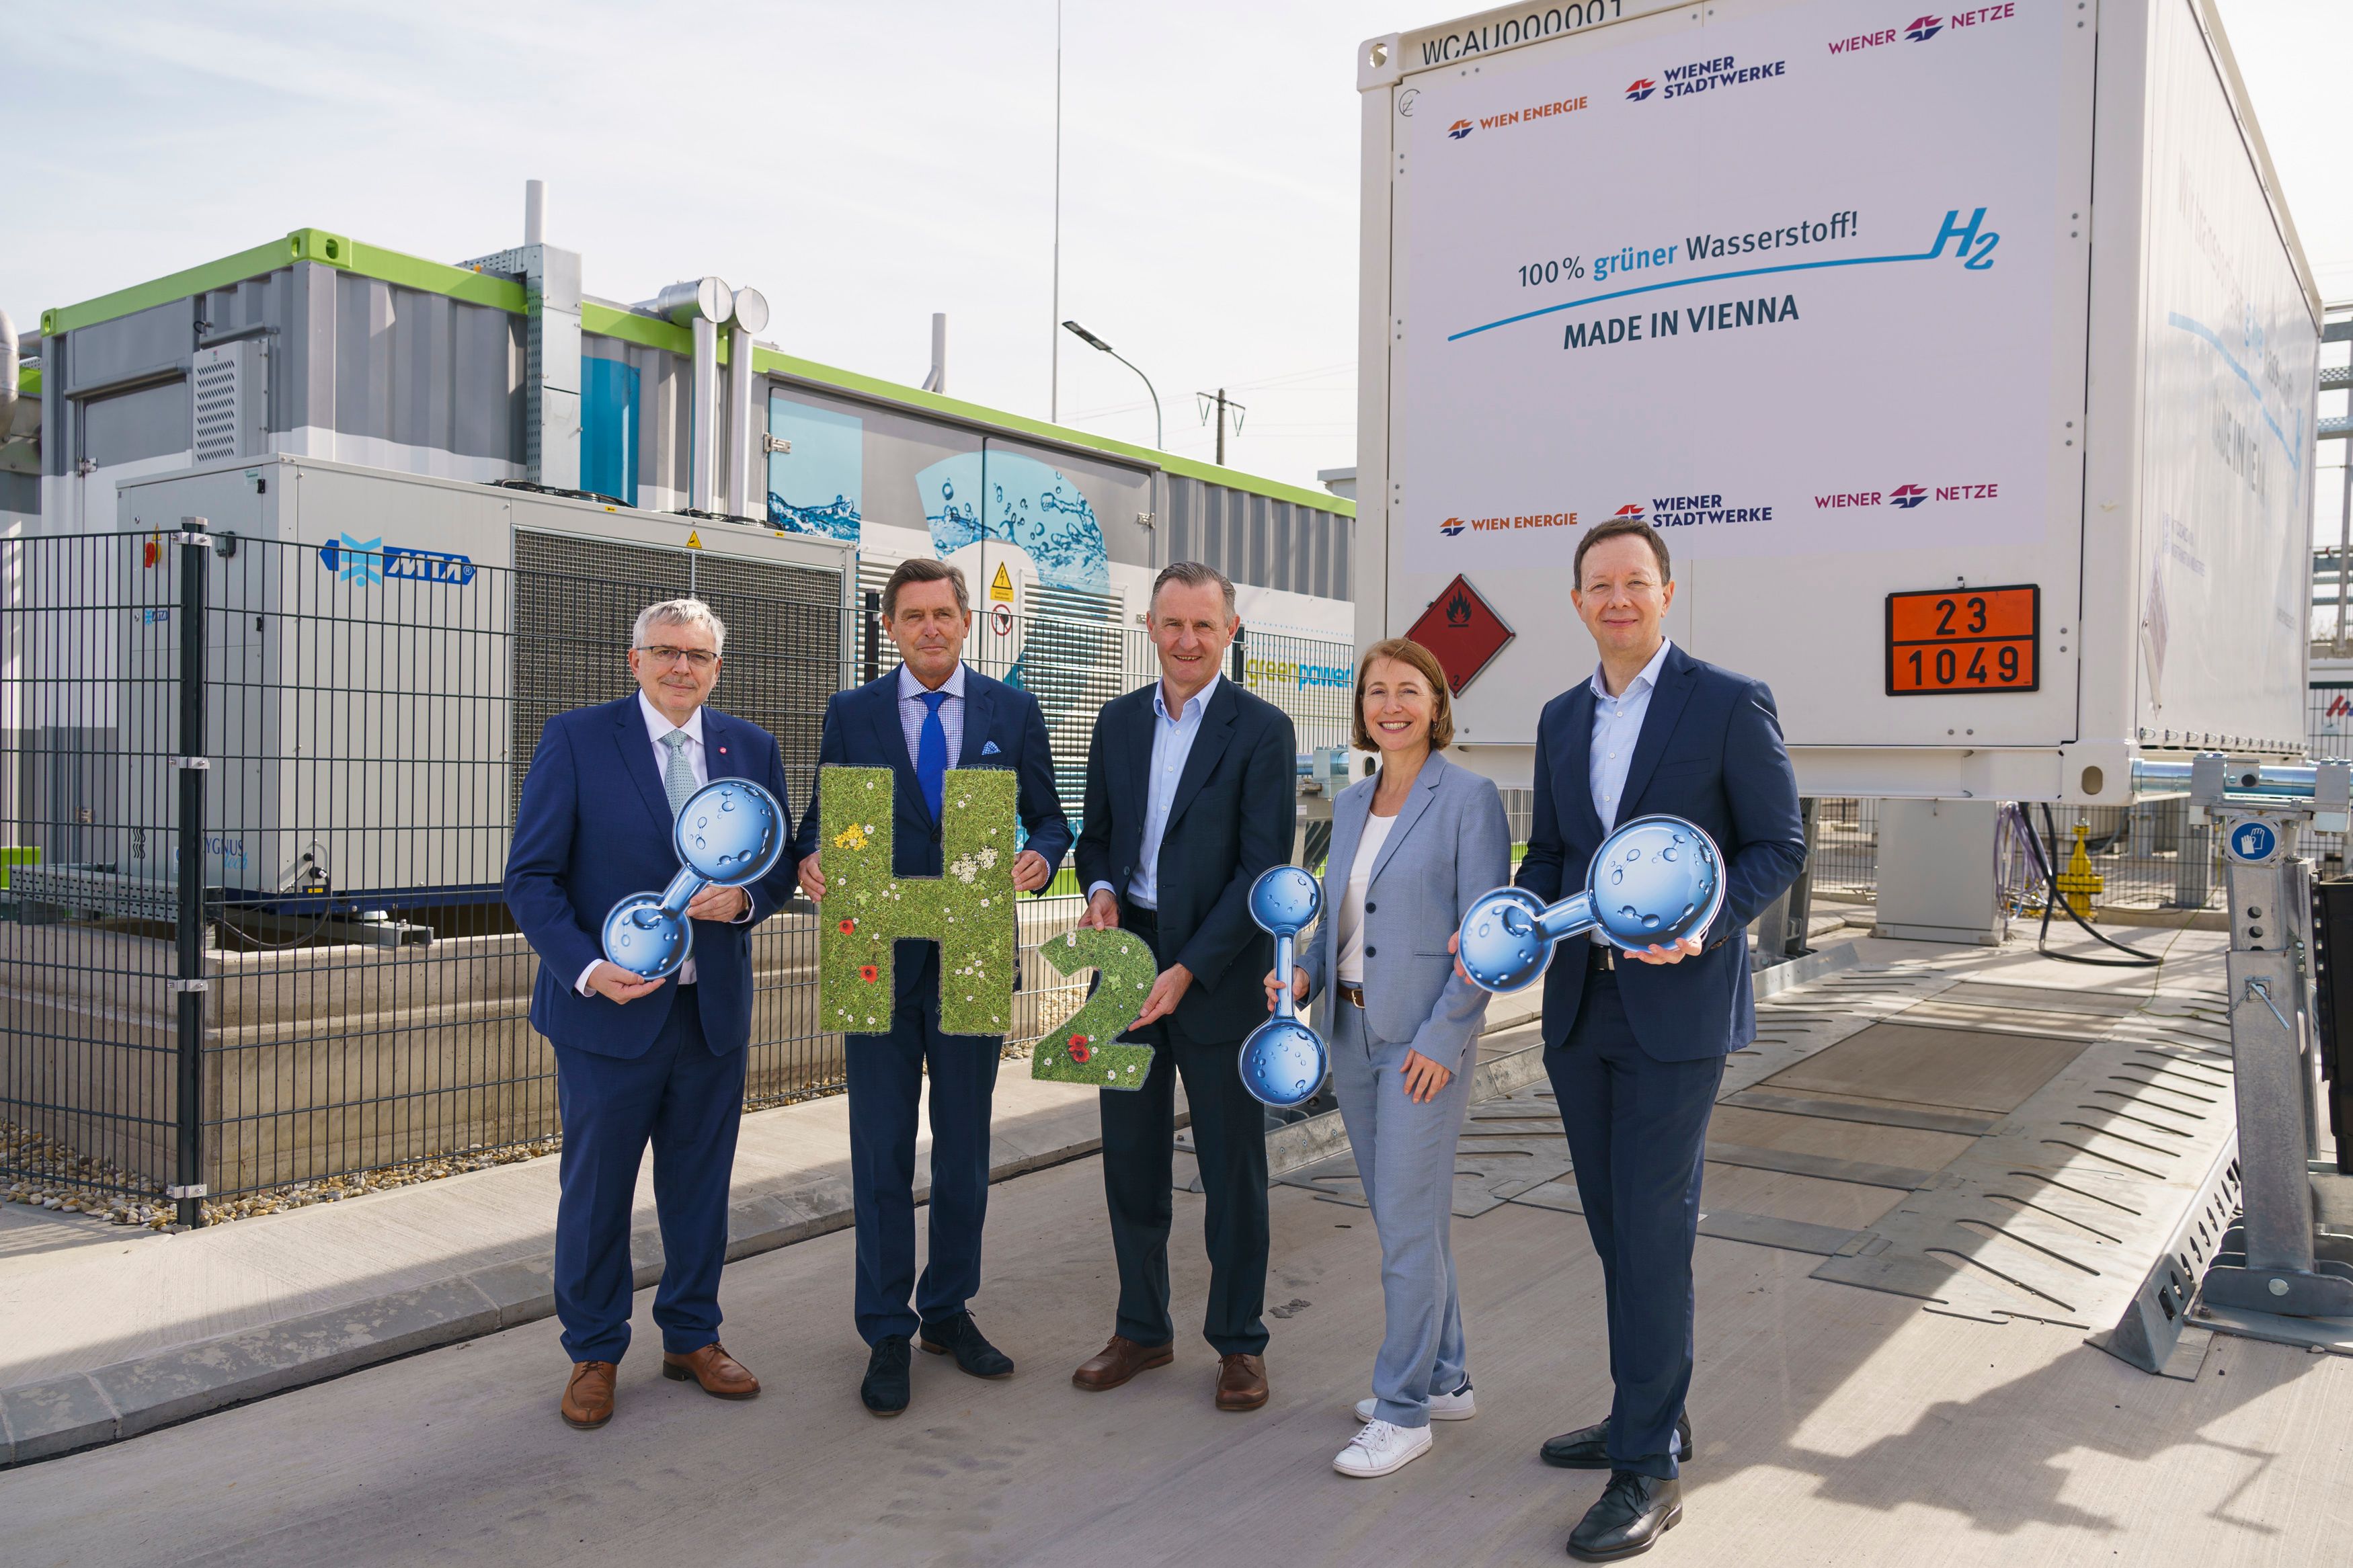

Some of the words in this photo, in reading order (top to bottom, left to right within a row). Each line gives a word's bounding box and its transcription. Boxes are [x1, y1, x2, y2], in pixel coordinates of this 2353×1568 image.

[1423, 0, 1622, 65] WCAU000001
[1829, 28, 1897, 55] WIENER
[1951, 3, 2015, 29] NETZE
[1664, 56, 1734, 82] WIENER
[1664, 60, 1786, 99] STADTWERKE
[1480, 112, 1519, 130] WIEN
[1523, 96, 1588, 121] ENERGIE
[1593, 245, 1678, 281] grüner
[1686, 211, 1858, 261] Wasserstoff!
[1564, 315, 1642, 350] MADE
[1651, 310, 1679, 338] IN
[1686, 294, 1800, 333] VIENNA
[1652, 495, 1722, 511] WIENER
[1814, 491, 1882, 509] WIENER
[1936, 484, 1998, 501] NETZE
[1472, 518, 1510, 531] WIEN
[1515, 513, 1578, 528] ENERGIE
[1652, 507, 1773, 528] STADTWERKE
[1936, 597, 1987, 635] 23
[1453, 675, 1460, 686] 2
[1909, 646, 2018, 686] 1049
[203, 837, 243, 856] YGNUS
